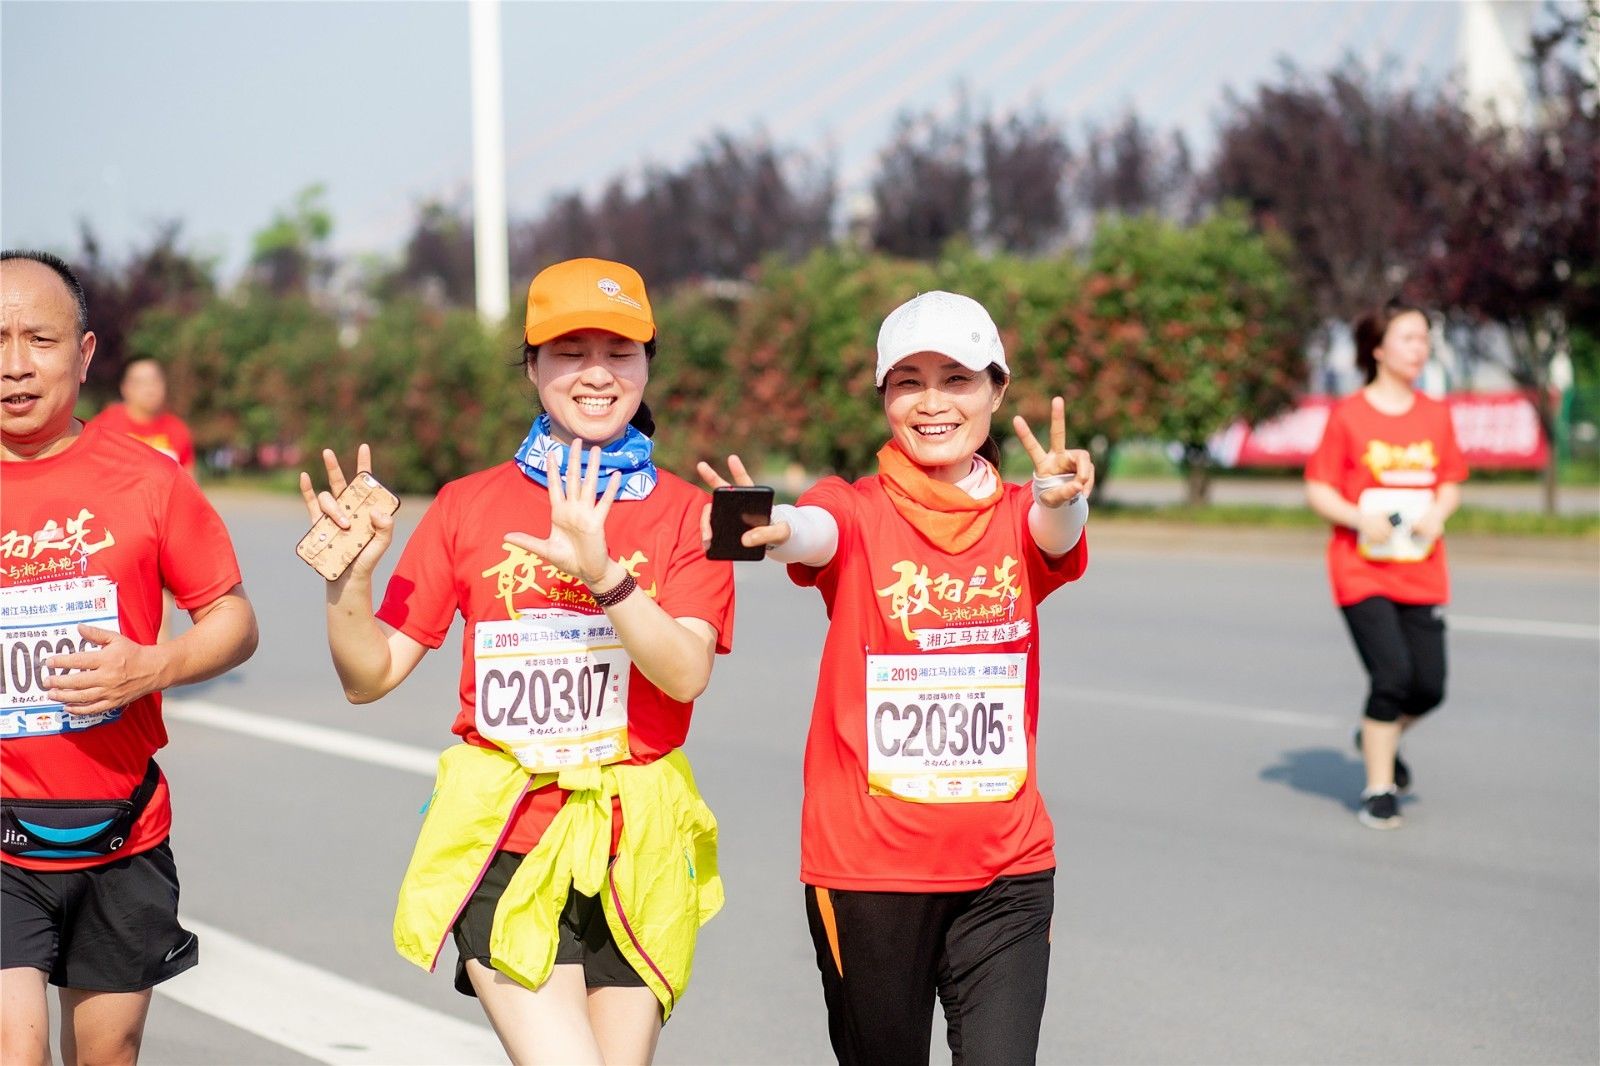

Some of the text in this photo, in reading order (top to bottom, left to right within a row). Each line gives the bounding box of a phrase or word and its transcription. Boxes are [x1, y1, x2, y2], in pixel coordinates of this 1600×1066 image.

[926, 625, 1019, 647] 湘江马拉松赛
[481, 663, 610, 728] C20307
[874, 702, 1005, 757] C20305
